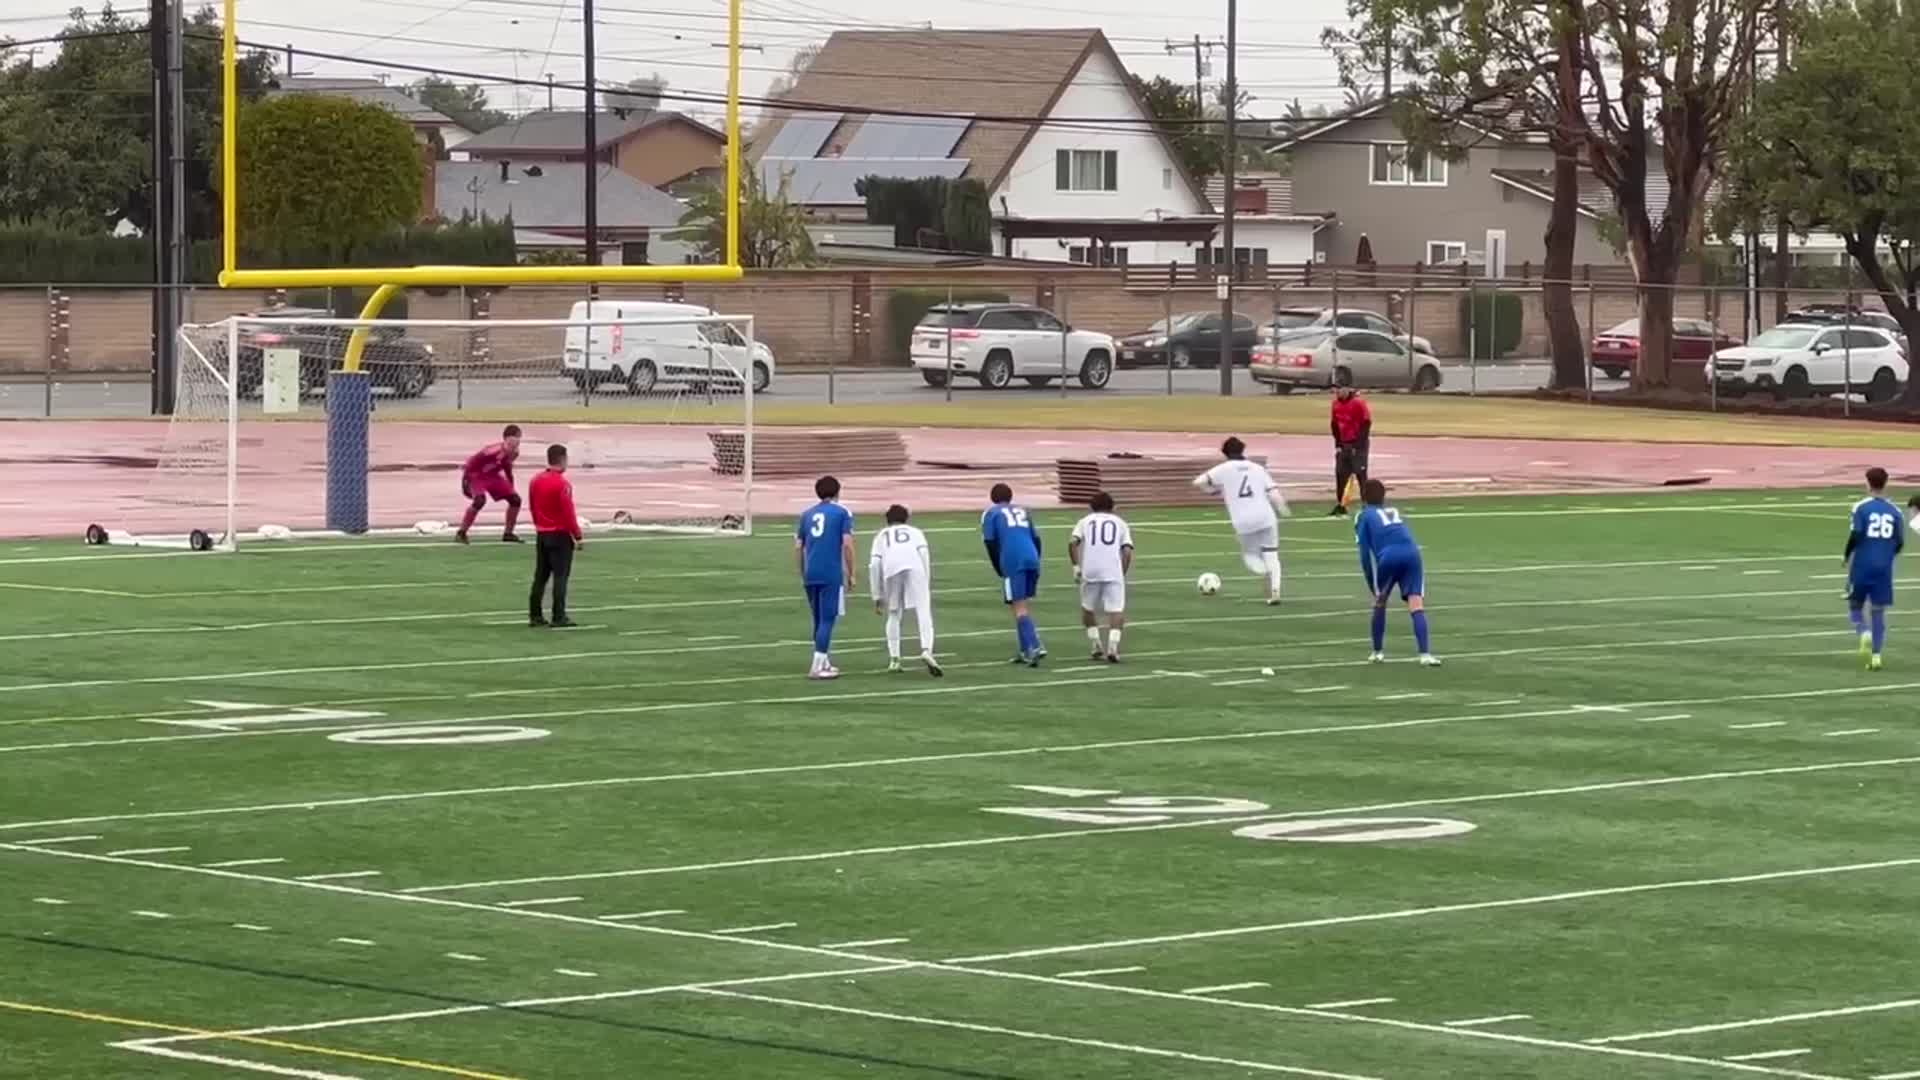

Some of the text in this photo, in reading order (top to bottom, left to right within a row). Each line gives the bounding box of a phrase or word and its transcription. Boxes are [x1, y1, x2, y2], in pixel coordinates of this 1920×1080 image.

[1238, 474, 1254, 498] 4
[811, 512, 825, 537] 3
[1001, 508, 1029, 528] 12
[1867, 512, 1895, 538] 26
[880, 527, 911, 548] 16
[1089, 520, 1117, 546] 10
